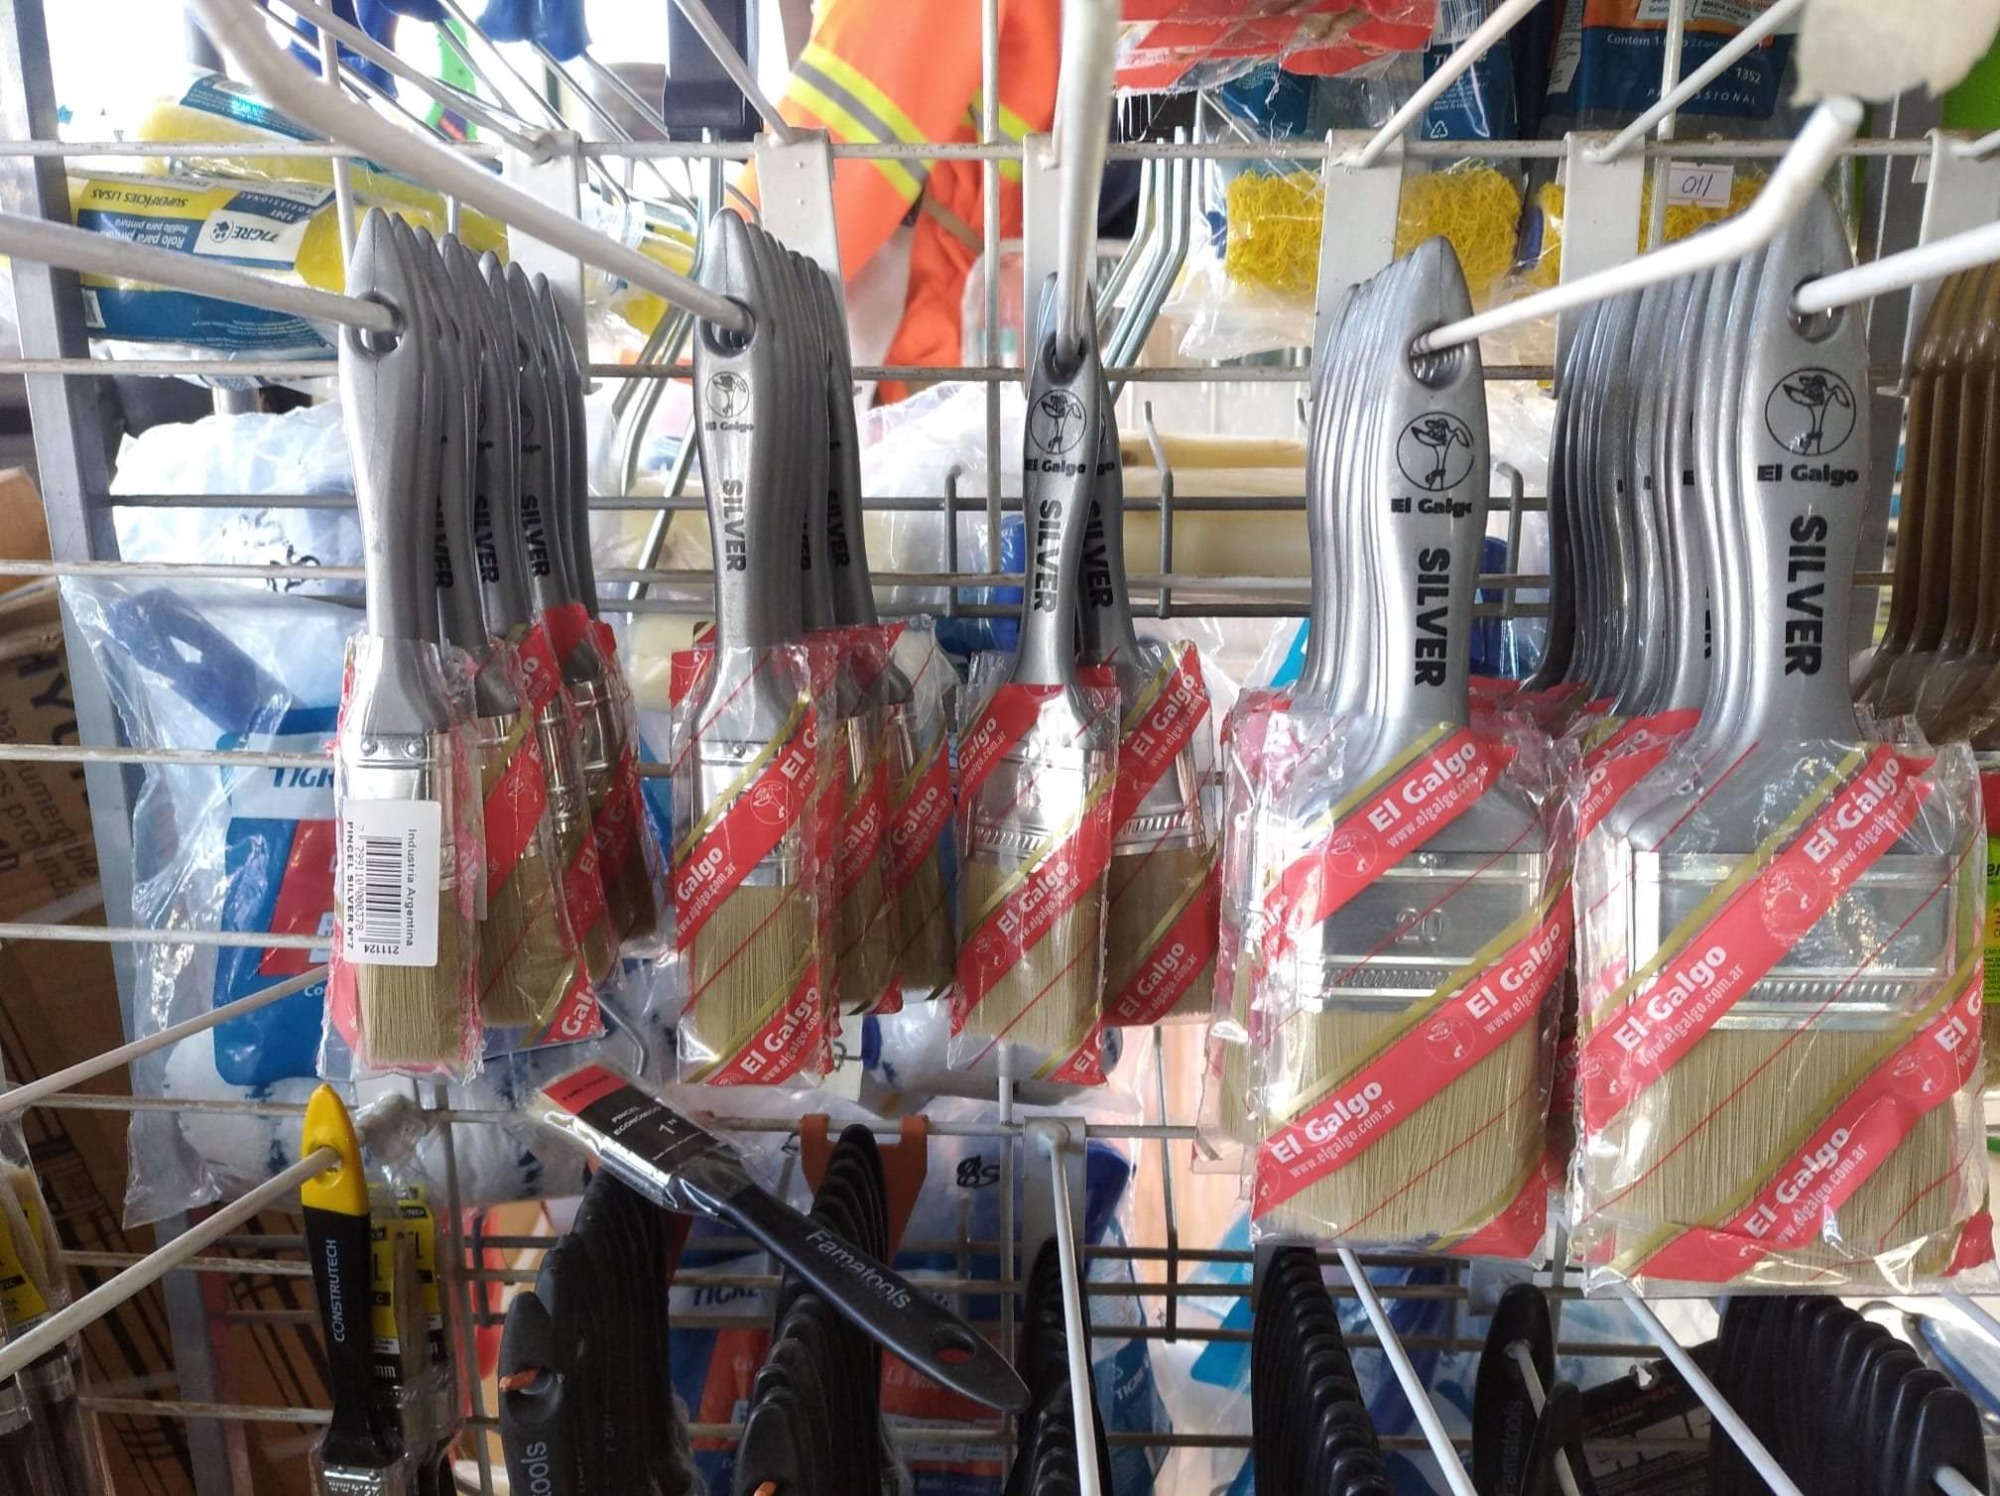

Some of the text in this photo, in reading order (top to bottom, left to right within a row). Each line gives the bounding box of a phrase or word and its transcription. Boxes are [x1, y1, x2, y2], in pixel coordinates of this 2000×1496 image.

[92, 189, 121, 203] LISAS
[115, 218, 189, 234] Rodillo para pintura
[232, 224, 280, 243] TIGRE
[137, 233, 162, 247] para
[165, 235, 185, 249] Rolo
[1024, 458, 1038, 472] El
[1041, 458, 1087, 477] Galgo
[1391, 498, 1412, 513] El
[1757, 464, 1860, 487] El Galgo
[521, 494, 551, 578] SILVER
[723, 479, 747, 573] SILVER
[1033, 499, 1063, 614] SILVER
[1414, 547, 1450, 687] SILVER
[1785, 514, 1829, 677] SILVER
[959, 718, 997, 770] Galgo
[1131, 674, 1195, 757] El Galgo
[780, 749, 807, 780] El
[1367, 742, 1476, 833] El Galgo
[347, 821, 355, 870] PINCEL
[891, 786, 939, 846] Galgo
[1803, 757, 1900, 864] El Galgo
[346, 874, 354, 923] SILVER
[404, 828, 418, 947] Industria Argentina
[677, 846, 724, 901] Galgo
[996, 860, 1069, 934] El Galgo
[1117, 943, 1185, 1019] El Galgo
[1465, 985, 1499, 1020] El
[1500, 923, 1560, 992] Galgo
[1613, 1015, 1649, 1051] El
[1646, 946, 1727, 1021] Galgo
[740, 986, 818, 1076] El Galgo
[1073, 1049, 1096, 1073] El
[1934, 1015, 1968, 1053] El
[1270, 1081, 1383, 1164] El Galgo
[1289, 1099, 1396, 1179] www.elgalgo.com.ar
[1743, 1127, 1850, 1239] El Galgo
[325, 1238, 345, 1343] CONSTRUTECH
[805, 1229, 911, 1310] Famatools
